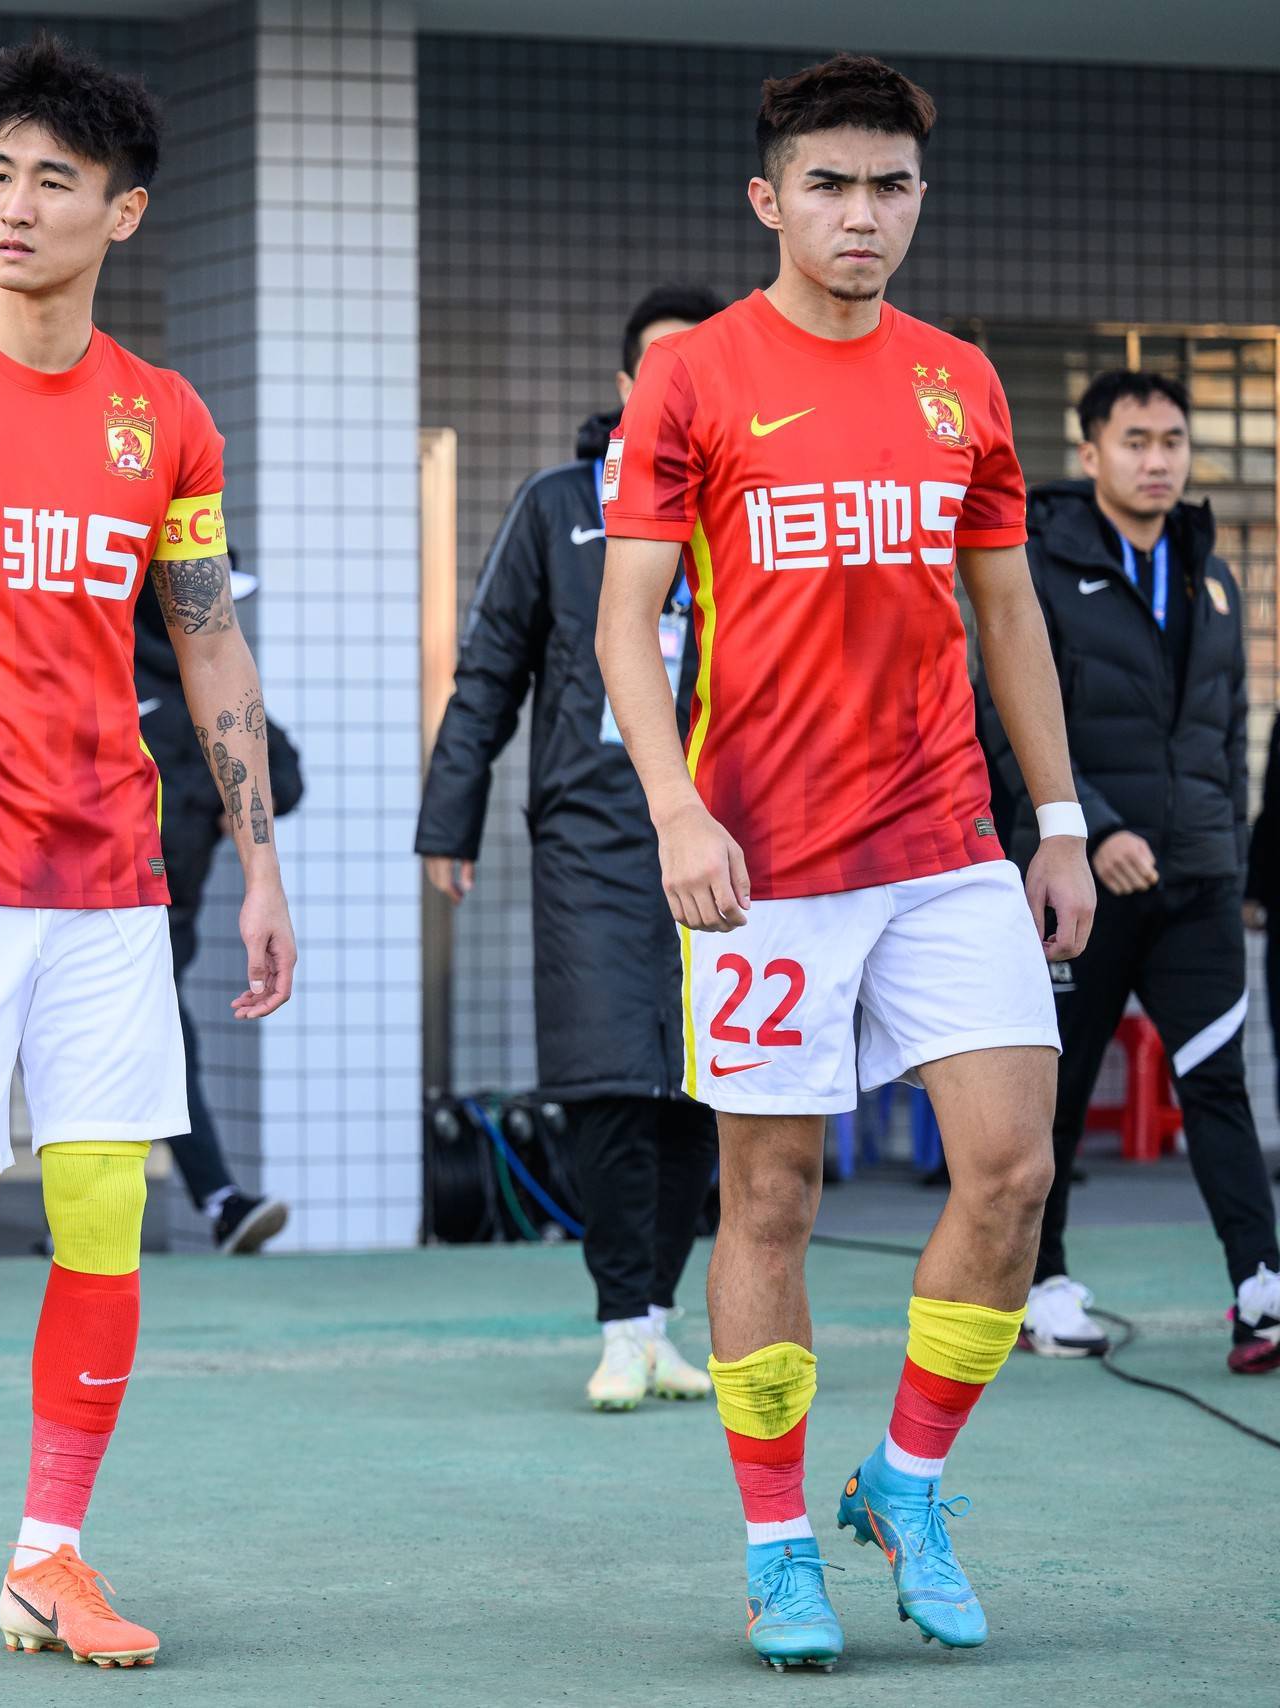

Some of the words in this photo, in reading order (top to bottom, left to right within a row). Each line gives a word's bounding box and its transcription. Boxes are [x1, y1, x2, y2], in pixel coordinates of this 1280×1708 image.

[189, 509, 212, 545] C
[744, 480, 967, 571] 恒驰5
[709, 953, 806, 1047] 22
